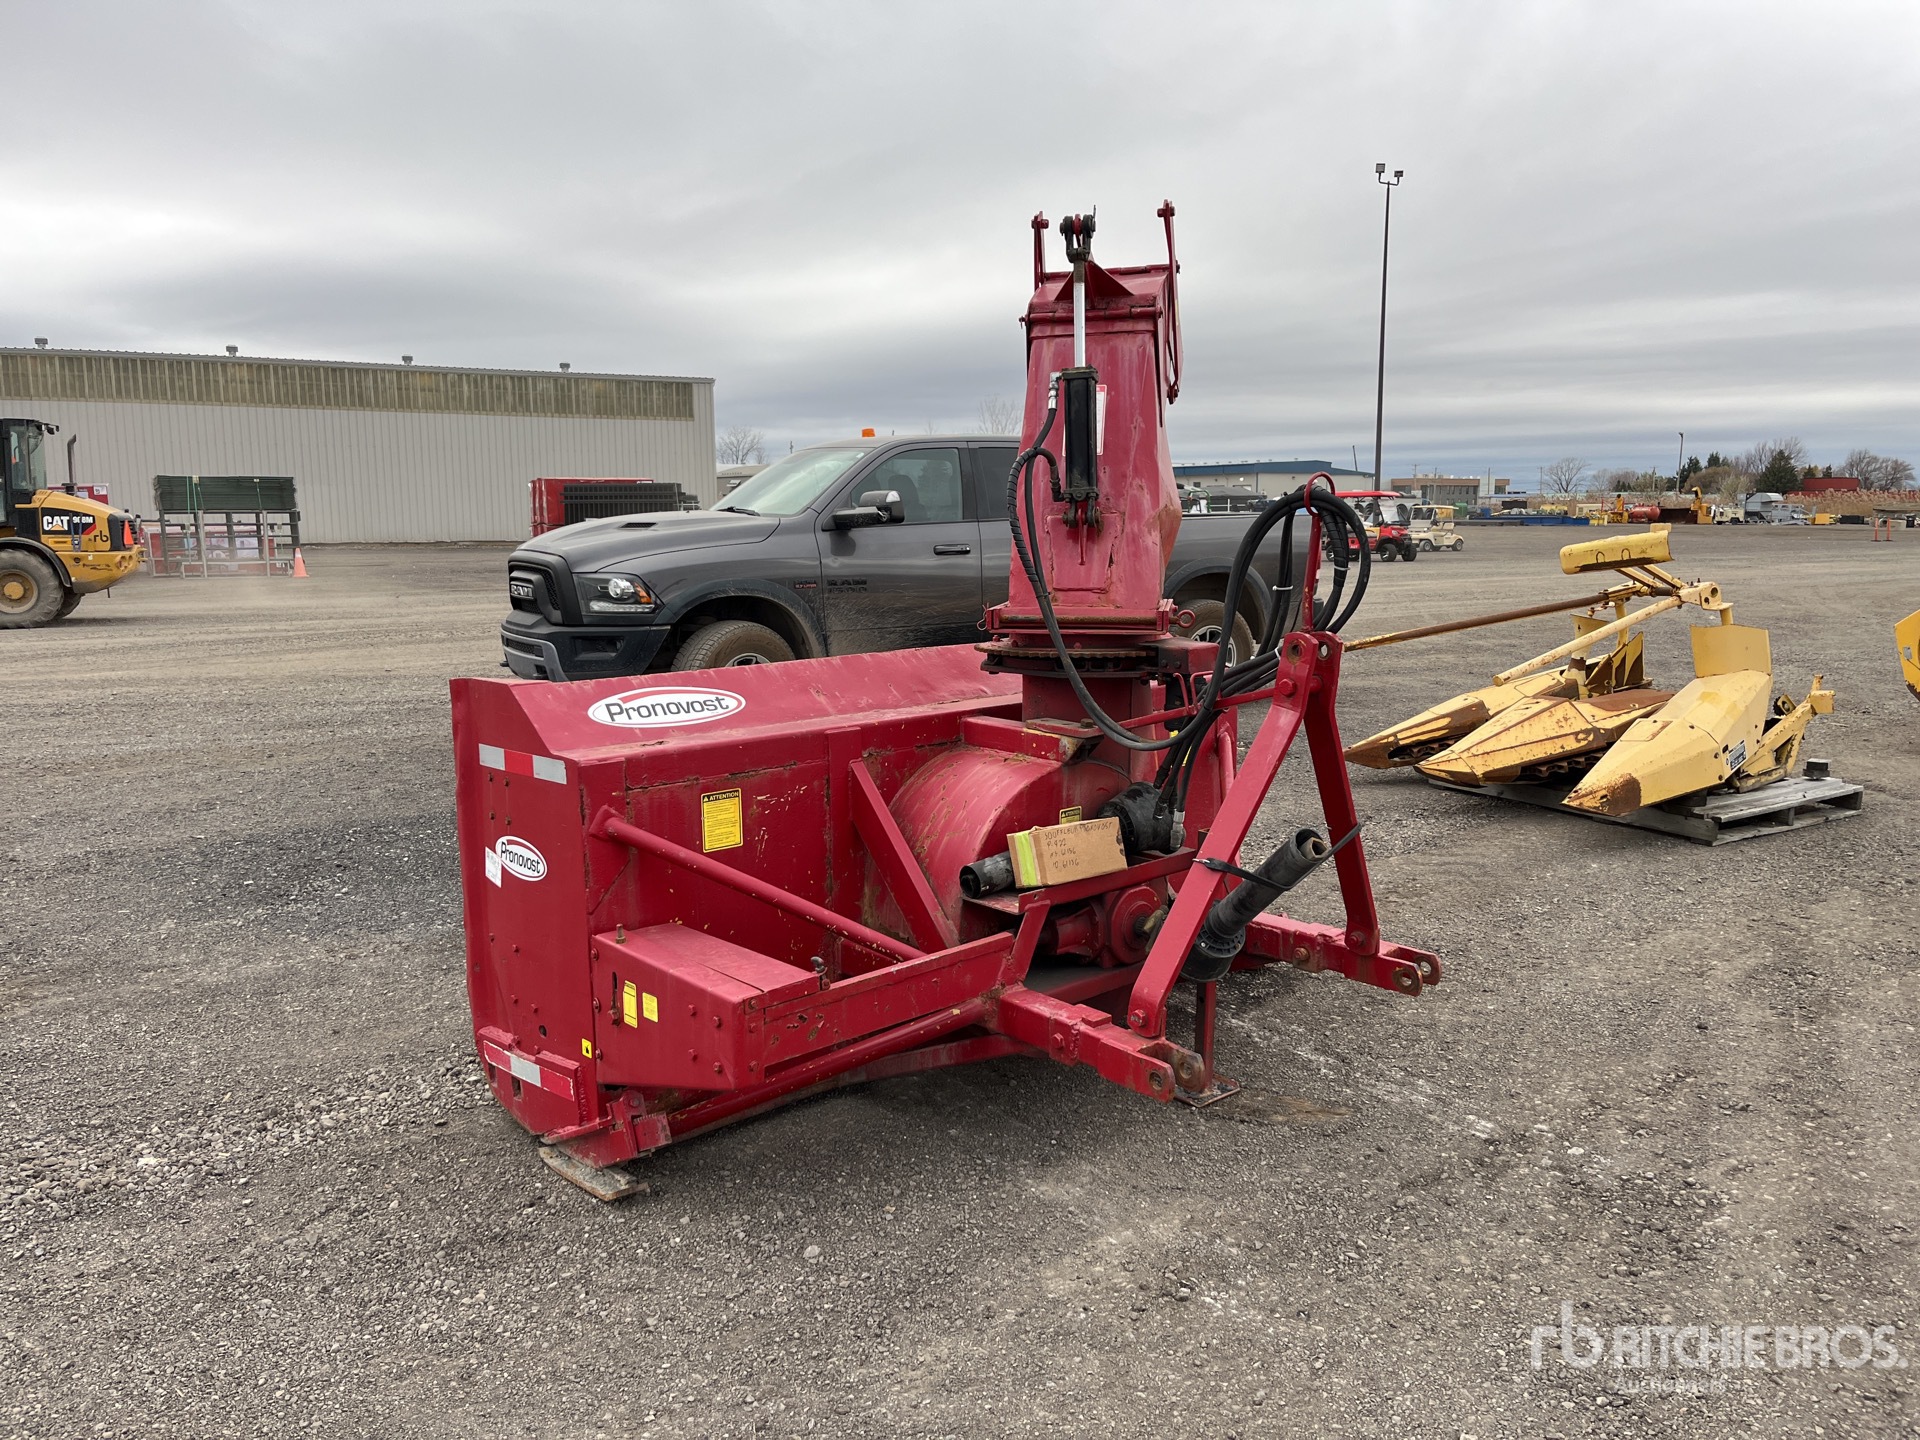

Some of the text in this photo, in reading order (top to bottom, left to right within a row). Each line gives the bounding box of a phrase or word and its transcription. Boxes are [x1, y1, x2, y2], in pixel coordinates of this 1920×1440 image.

[43, 516, 69, 531] CAT
[94, 530, 109, 542] rb
[605, 696, 730, 722] Pronovost
[709, 791, 739, 801] ATTENTION
[501, 841, 540, 874] Pronovost
